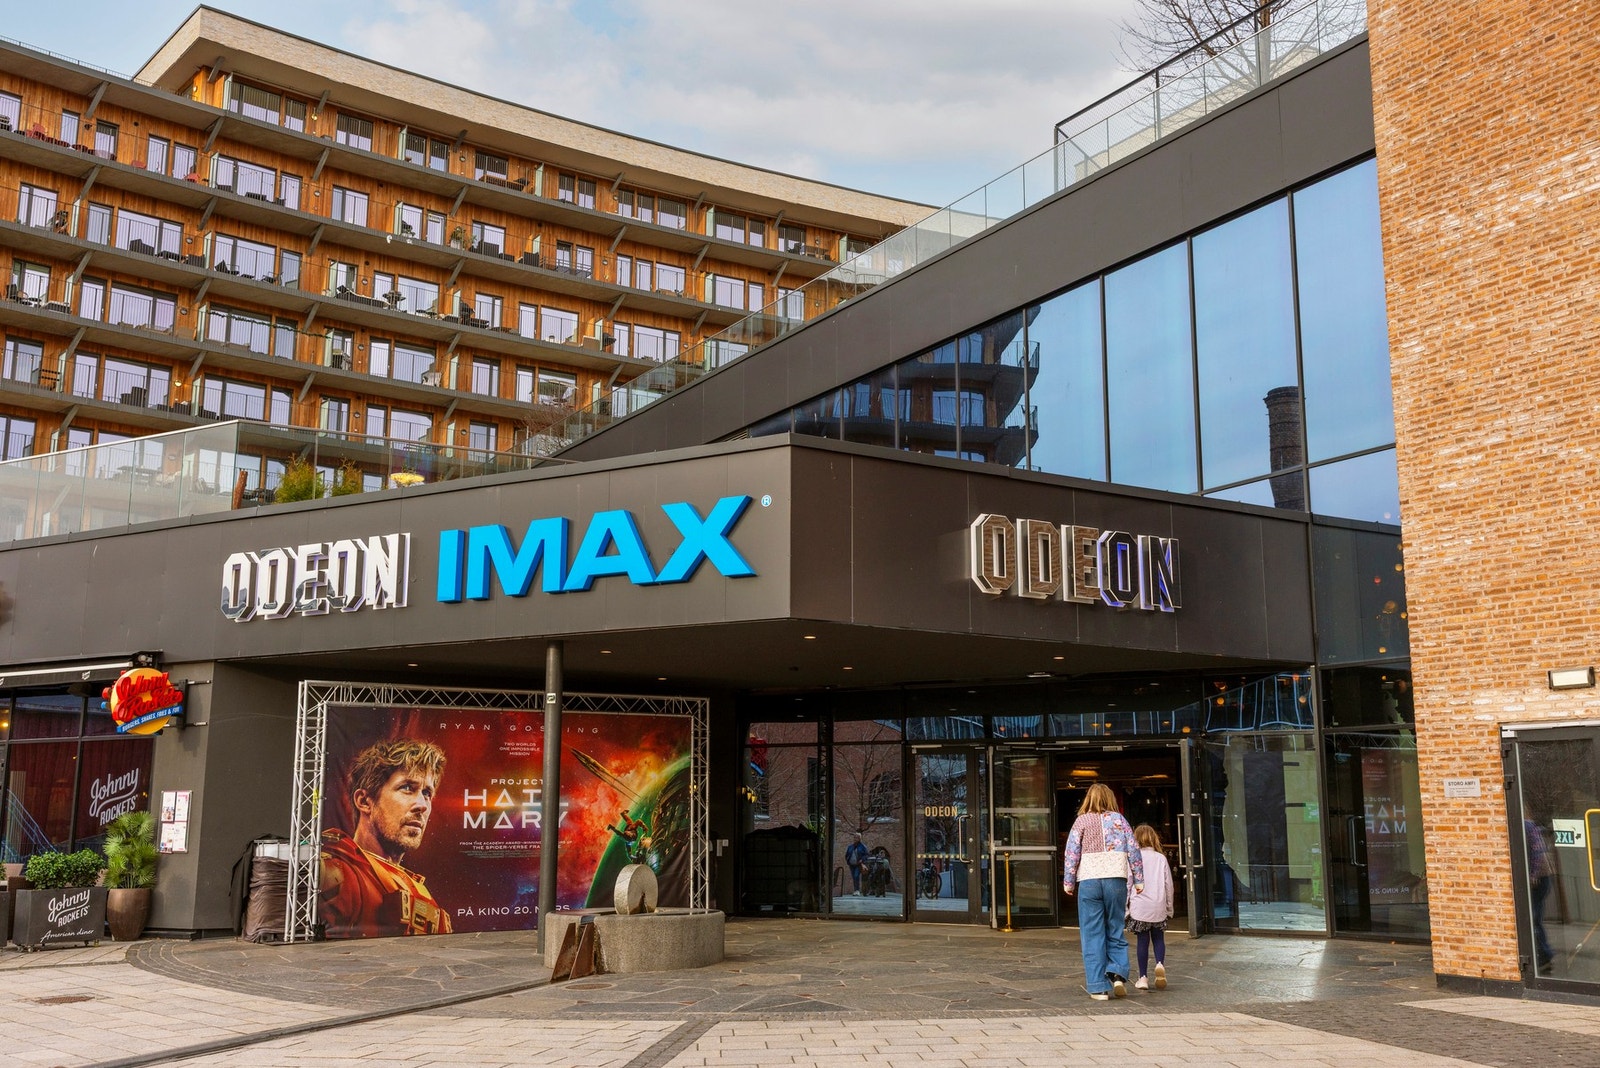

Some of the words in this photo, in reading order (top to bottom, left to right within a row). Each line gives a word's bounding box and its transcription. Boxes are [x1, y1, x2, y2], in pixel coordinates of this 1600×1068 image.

[220, 532, 411, 623] ODEON
[436, 494, 757, 603] IMAX
[970, 513, 1182, 612] ODEON
[112, 672, 169, 716] Johnny
[124, 686, 183, 719] Rockets
[440, 723, 491, 731] RYAN
[89, 767, 139, 817] Johnny
[100, 795, 137, 826] ROCKETS
[925, 805, 958, 817] ODEON
[1555, 831, 1574, 844] XXL
[47, 889, 91, 922] Johnny
[57, 905, 90, 927] ROCKETS
[457, 907, 474, 917] PÅ
[478, 906, 510, 916] KINO
[514, 906, 532, 915] 20.
[40, 930, 75, 943] American
[76, 928, 95, 936] diner
